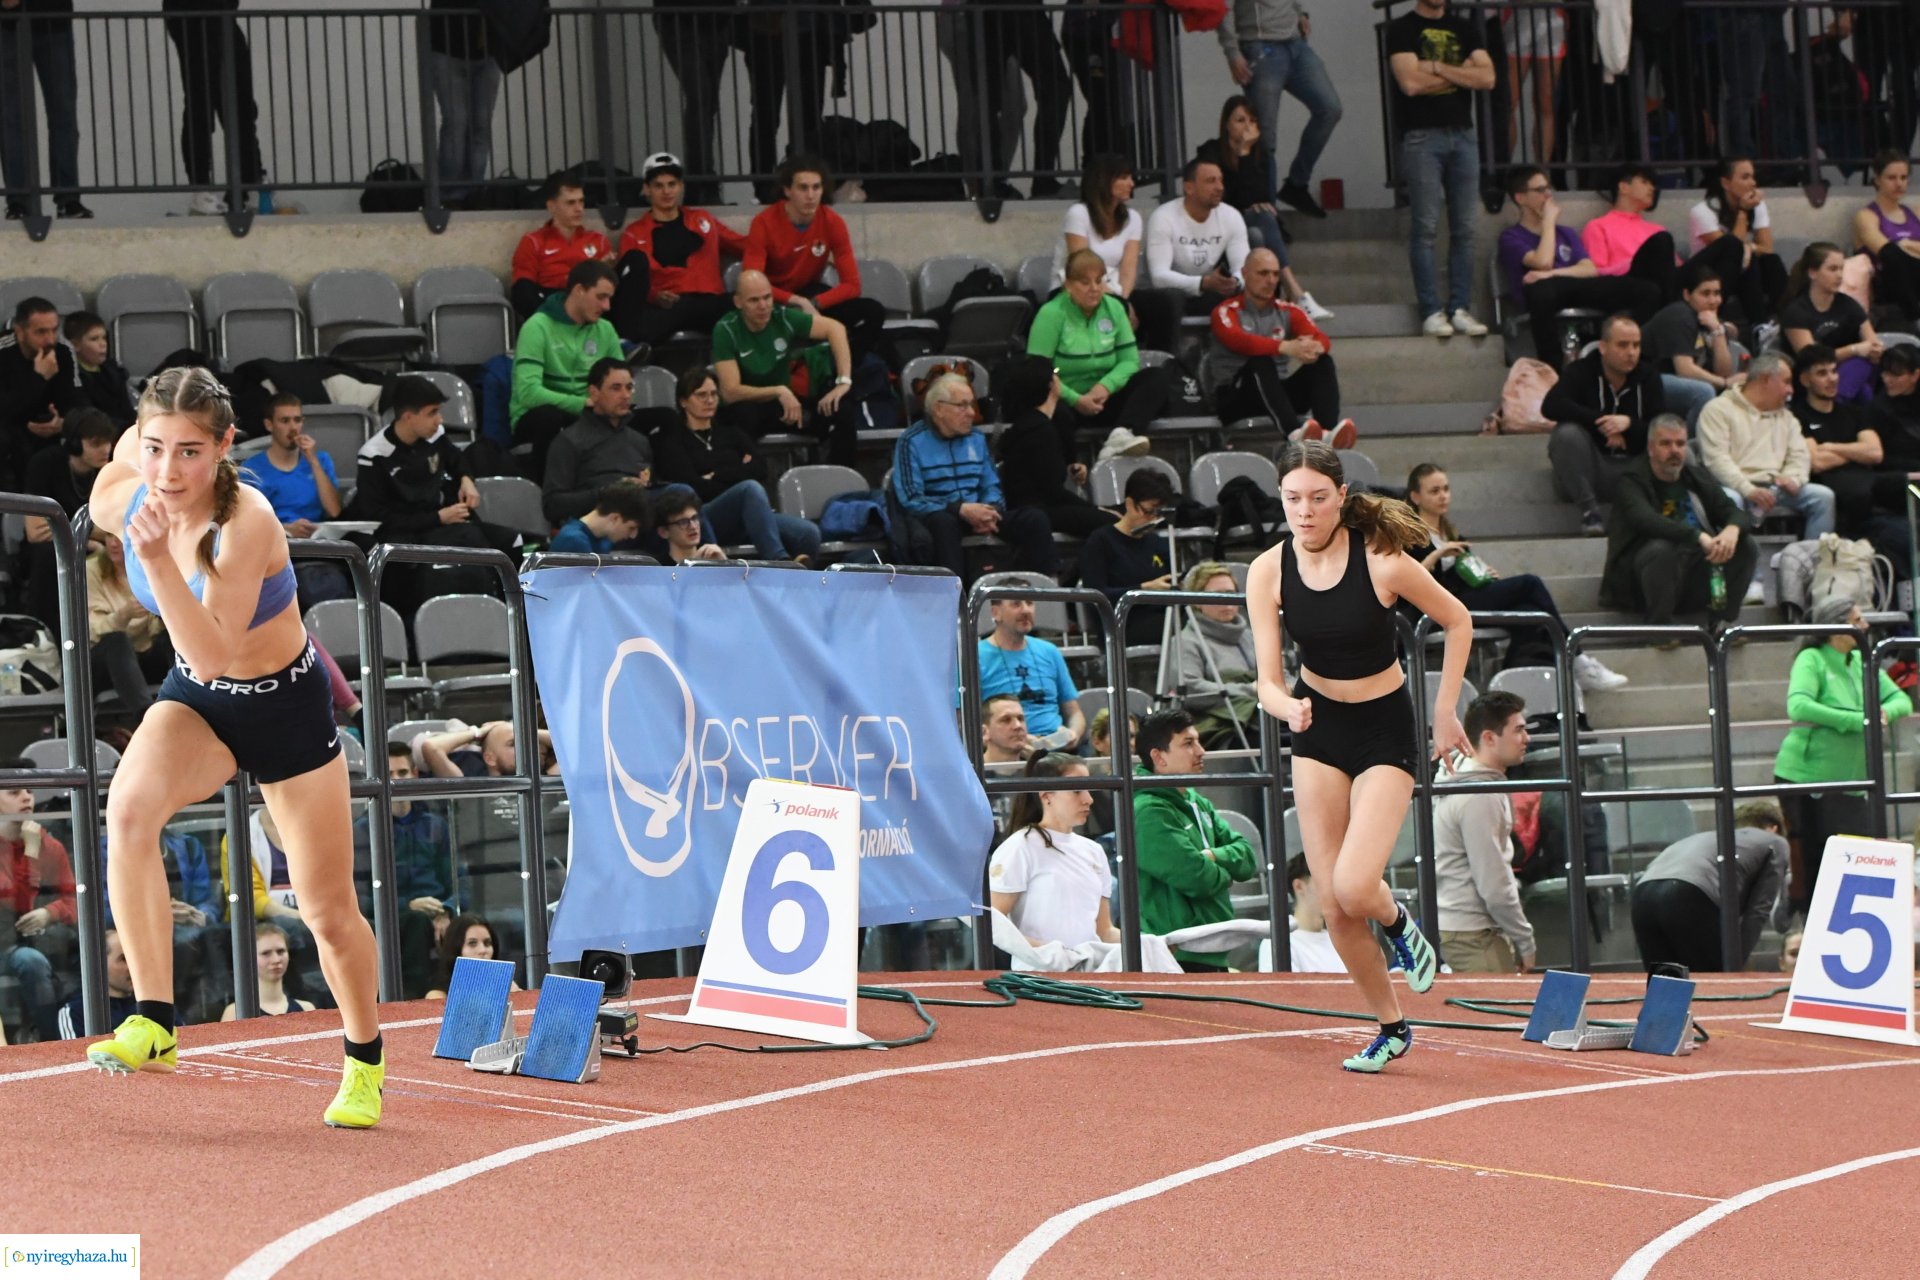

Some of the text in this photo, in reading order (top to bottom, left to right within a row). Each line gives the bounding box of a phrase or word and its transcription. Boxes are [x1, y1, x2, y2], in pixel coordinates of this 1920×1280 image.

[1179, 235, 1222, 246] GANT
[209, 678, 279, 695] PRO
[290, 638, 317, 683] NIK
[784, 803, 840, 820] polanik
[1855, 855, 1898, 867] polanik
[742, 829, 836, 976] 6
[1821, 873, 1896, 990] 5
